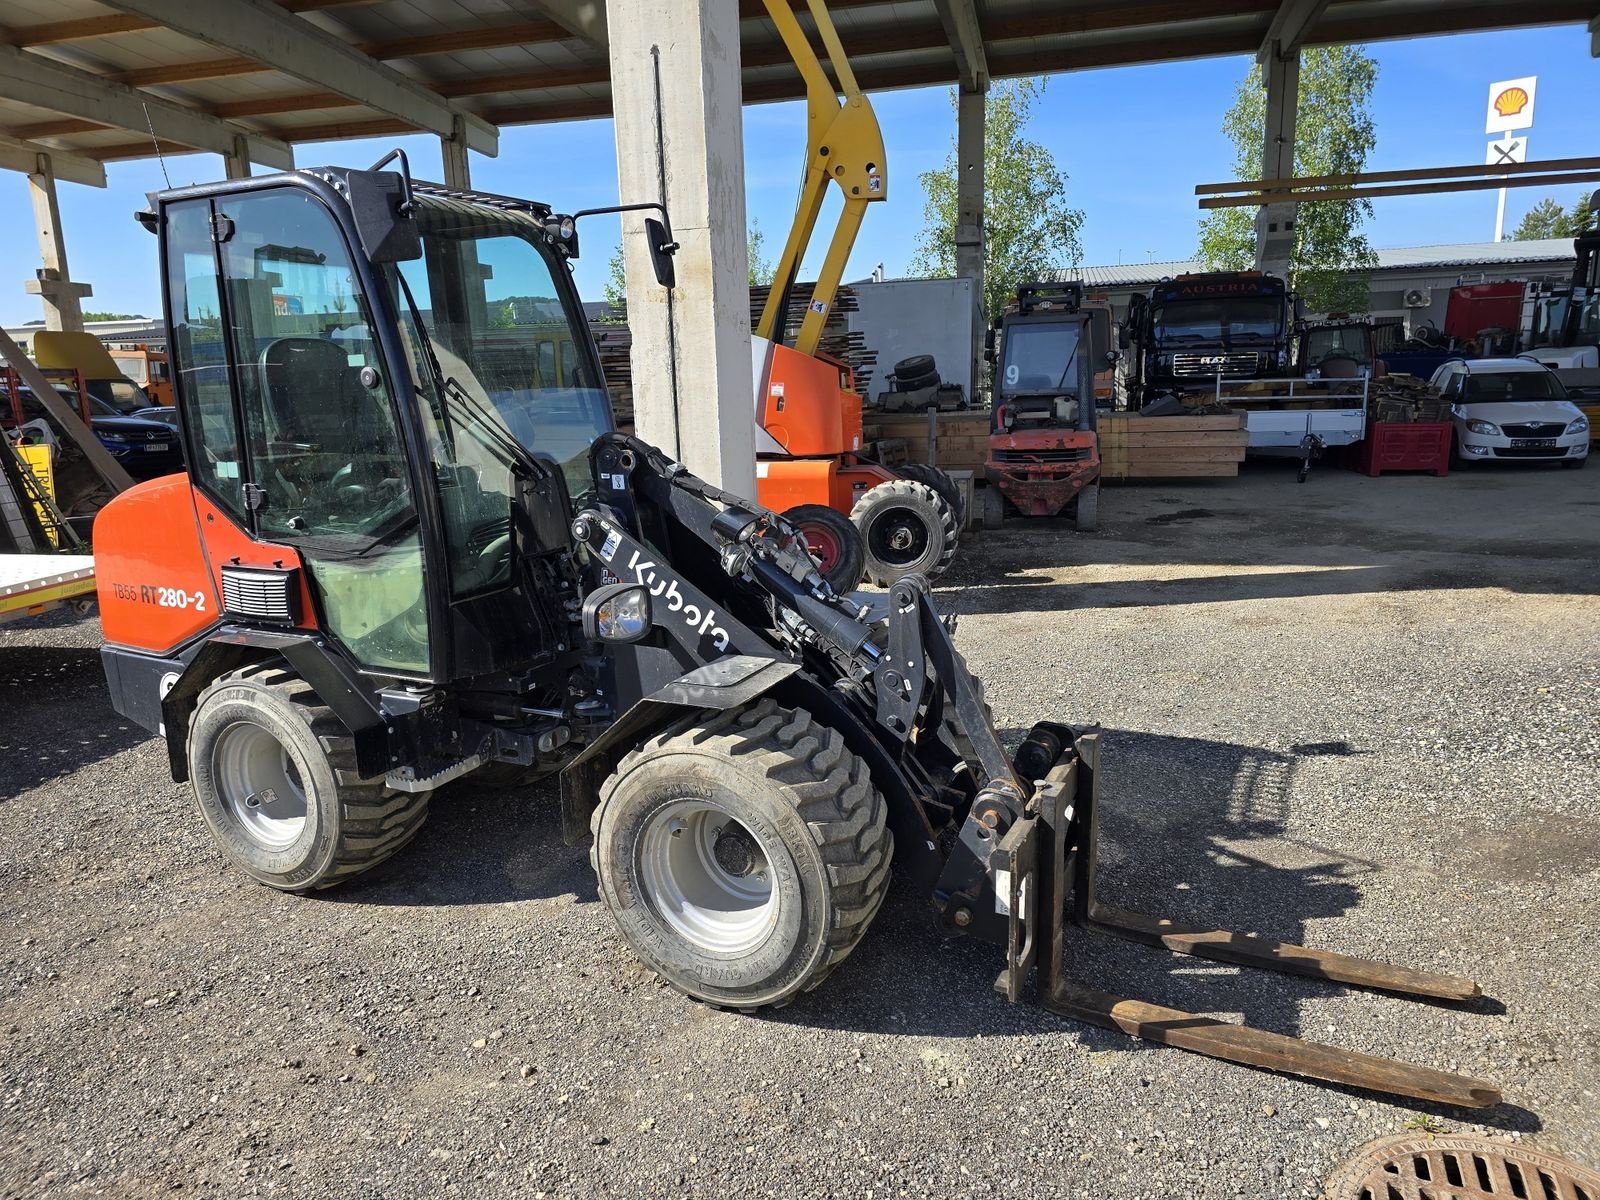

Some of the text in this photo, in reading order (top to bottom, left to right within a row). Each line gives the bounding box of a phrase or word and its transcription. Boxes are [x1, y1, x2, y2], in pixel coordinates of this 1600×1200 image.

[1183, 283, 1257, 294] AUSTRIA
[1006, 364, 1019, 385] 9
[112, 583, 137, 601] TB55
[628, 550, 730, 652] Kubota
[1414, 1140, 1485, 1151] WALLNER
[1504, 1148, 1586, 1179] NEUBERT
